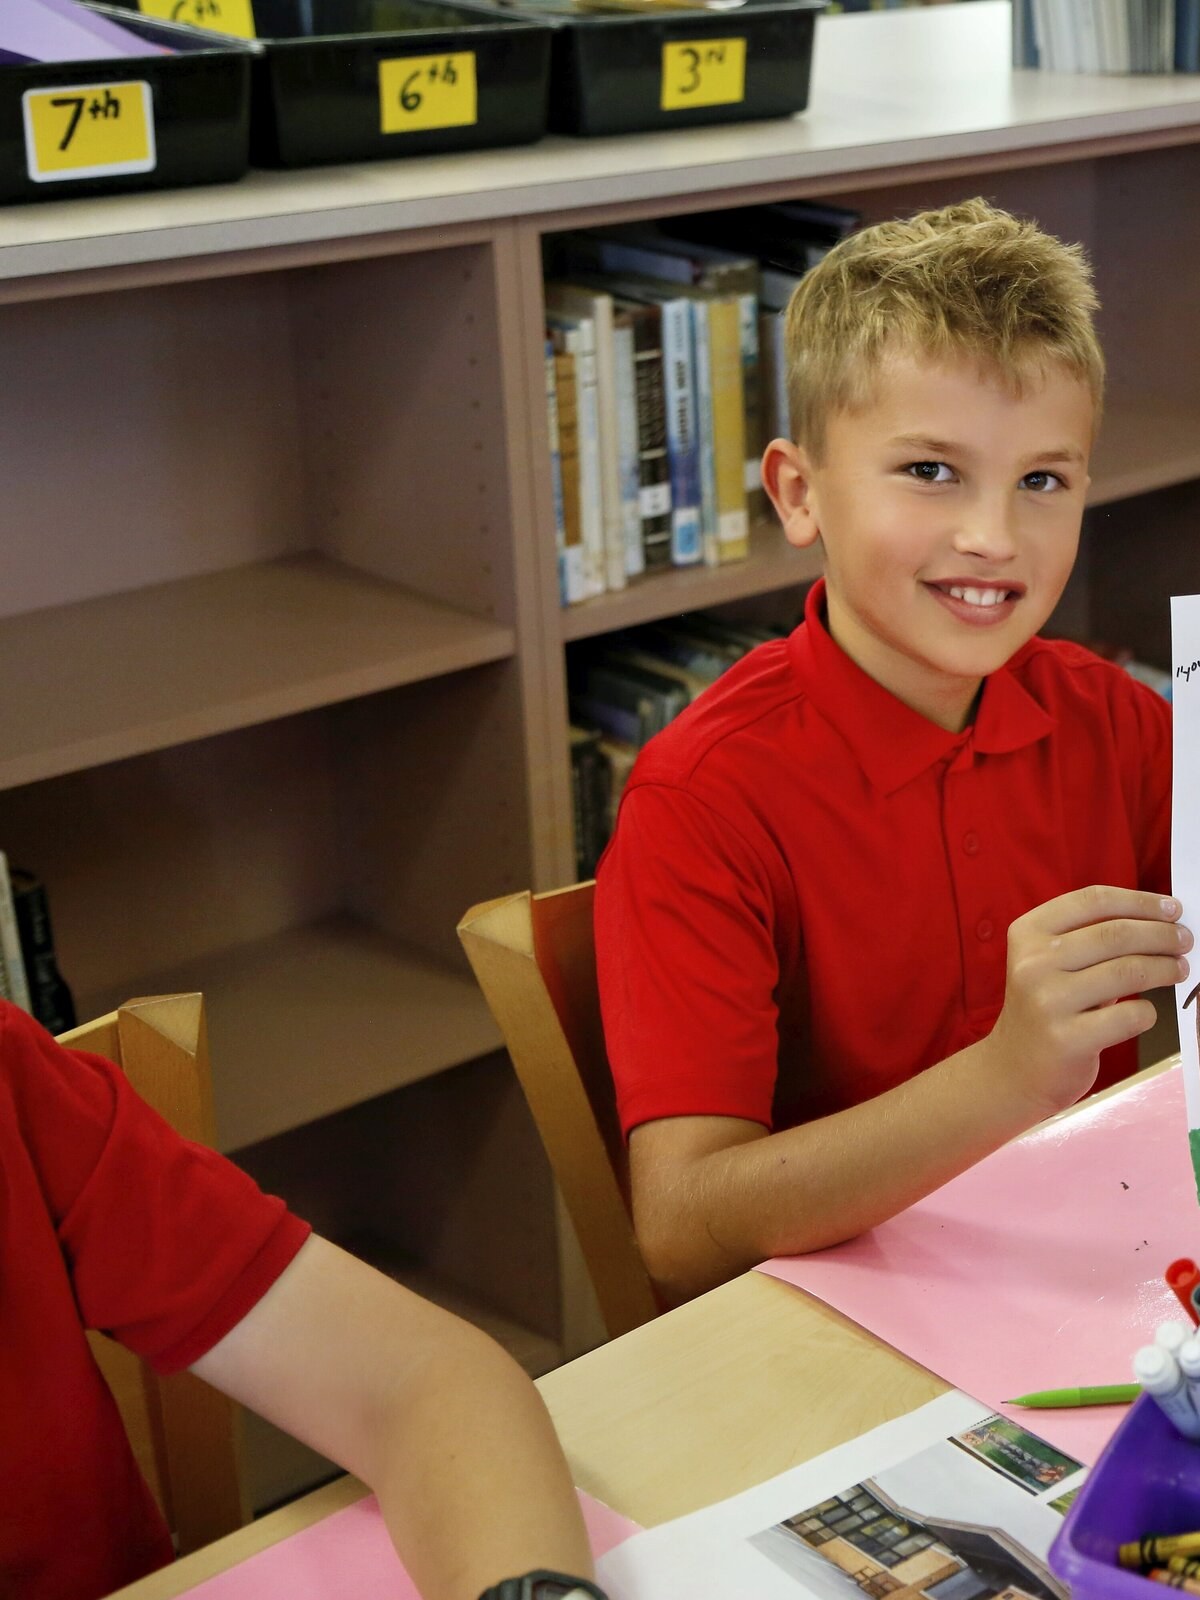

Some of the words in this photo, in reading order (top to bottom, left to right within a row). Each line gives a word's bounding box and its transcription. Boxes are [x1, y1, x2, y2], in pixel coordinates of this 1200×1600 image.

[399, 58, 458, 112] 6th
[678, 46, 727, 95] 3rd
[50, 88, 121, 151] 7th
